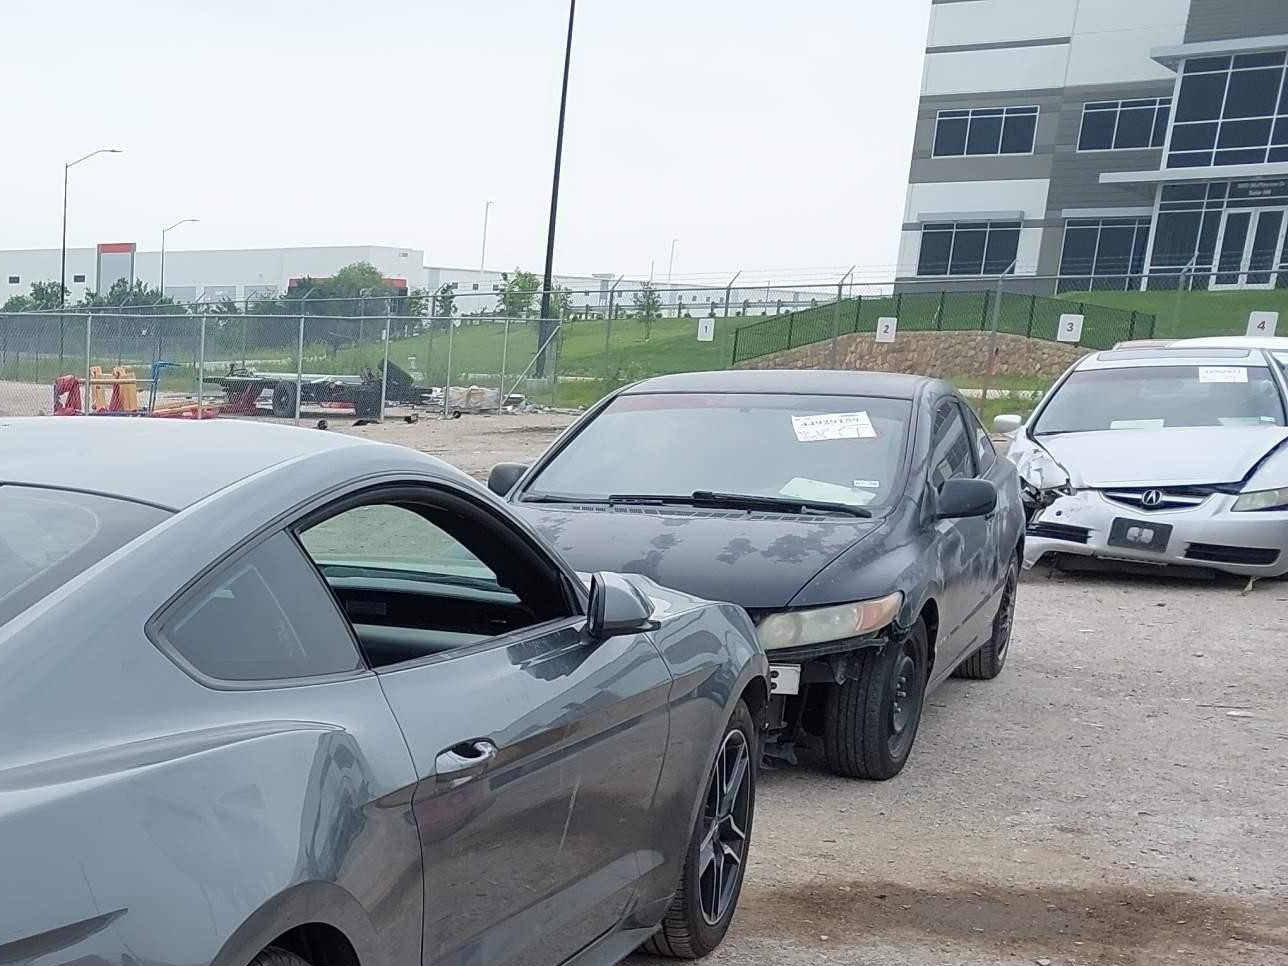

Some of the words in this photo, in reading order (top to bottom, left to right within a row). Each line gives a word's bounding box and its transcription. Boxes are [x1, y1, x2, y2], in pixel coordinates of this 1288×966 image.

[883, 324, 890, 334] 2
[1066, 322, 1075, 333] 3
[1256, 320, 1267, 331] 4
